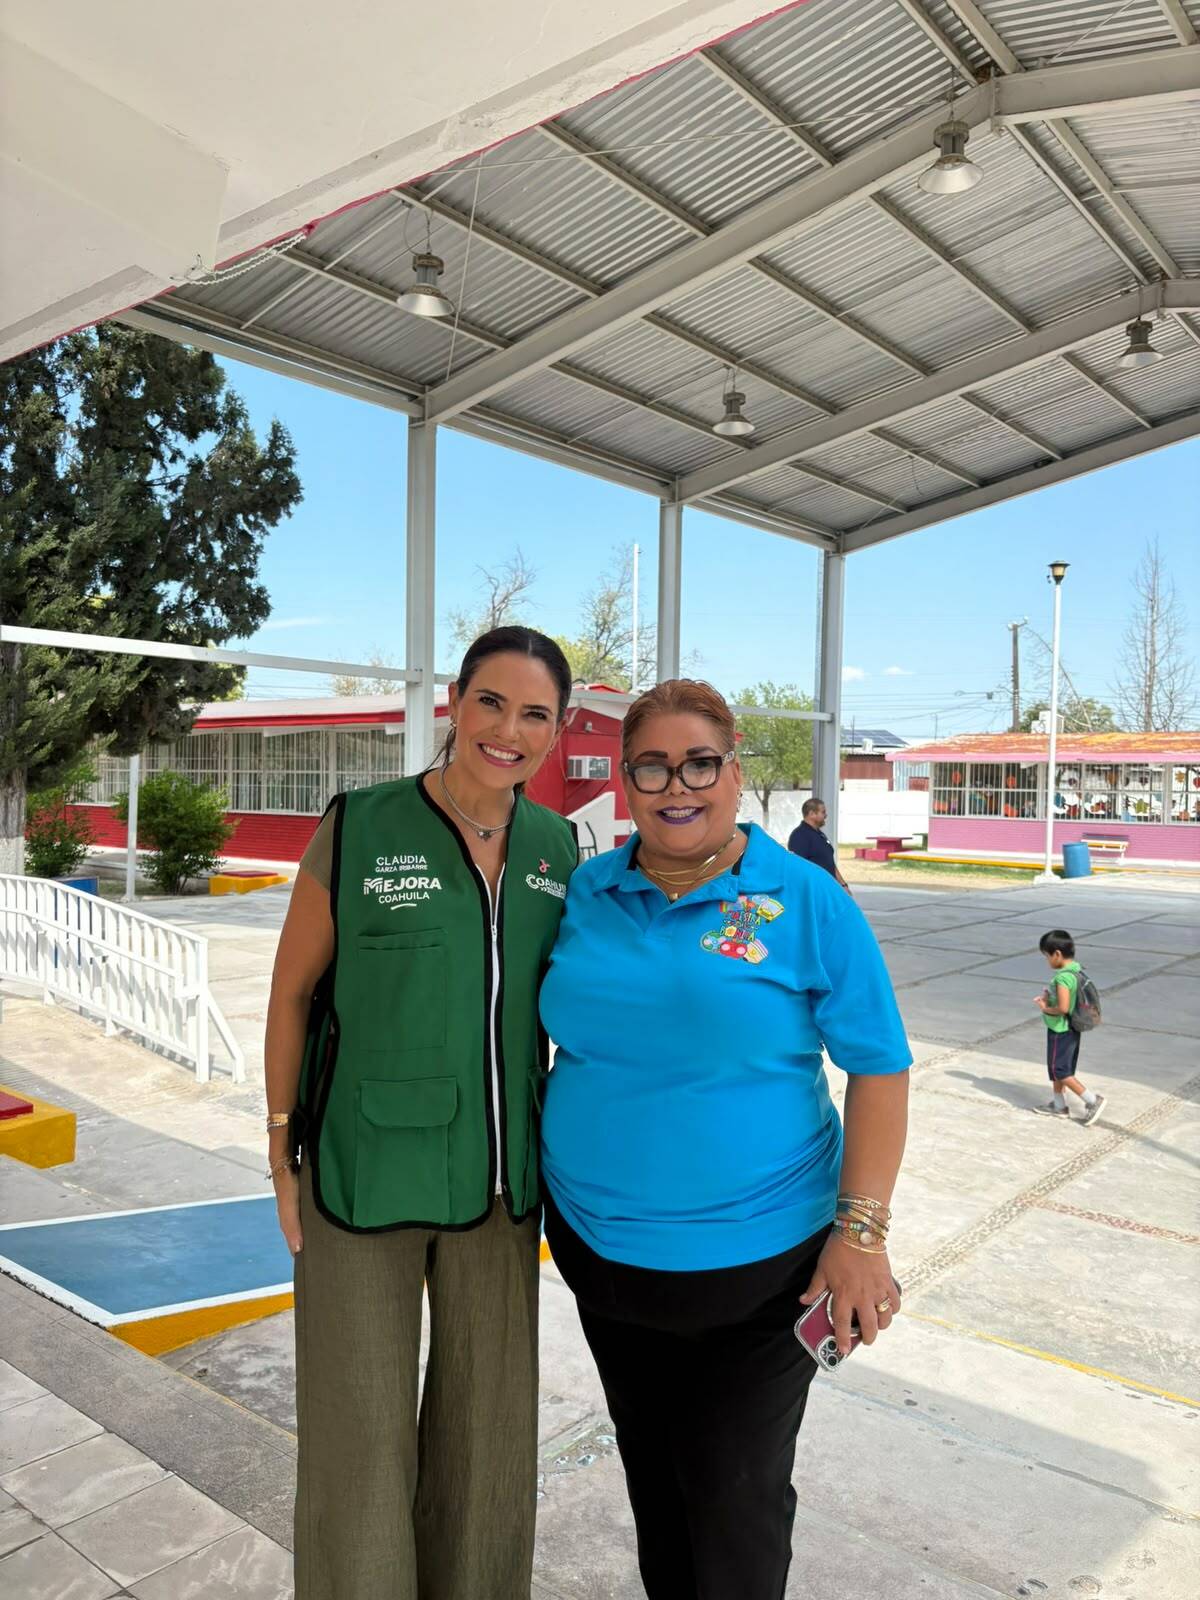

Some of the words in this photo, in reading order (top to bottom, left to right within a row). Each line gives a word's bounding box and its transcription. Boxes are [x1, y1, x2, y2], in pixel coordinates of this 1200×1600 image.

[376, 855, 427, 866] CLAUDIA
[363, 877, 442, 895] MEJORA
[378, 891, 430, 904] COAHUILA
